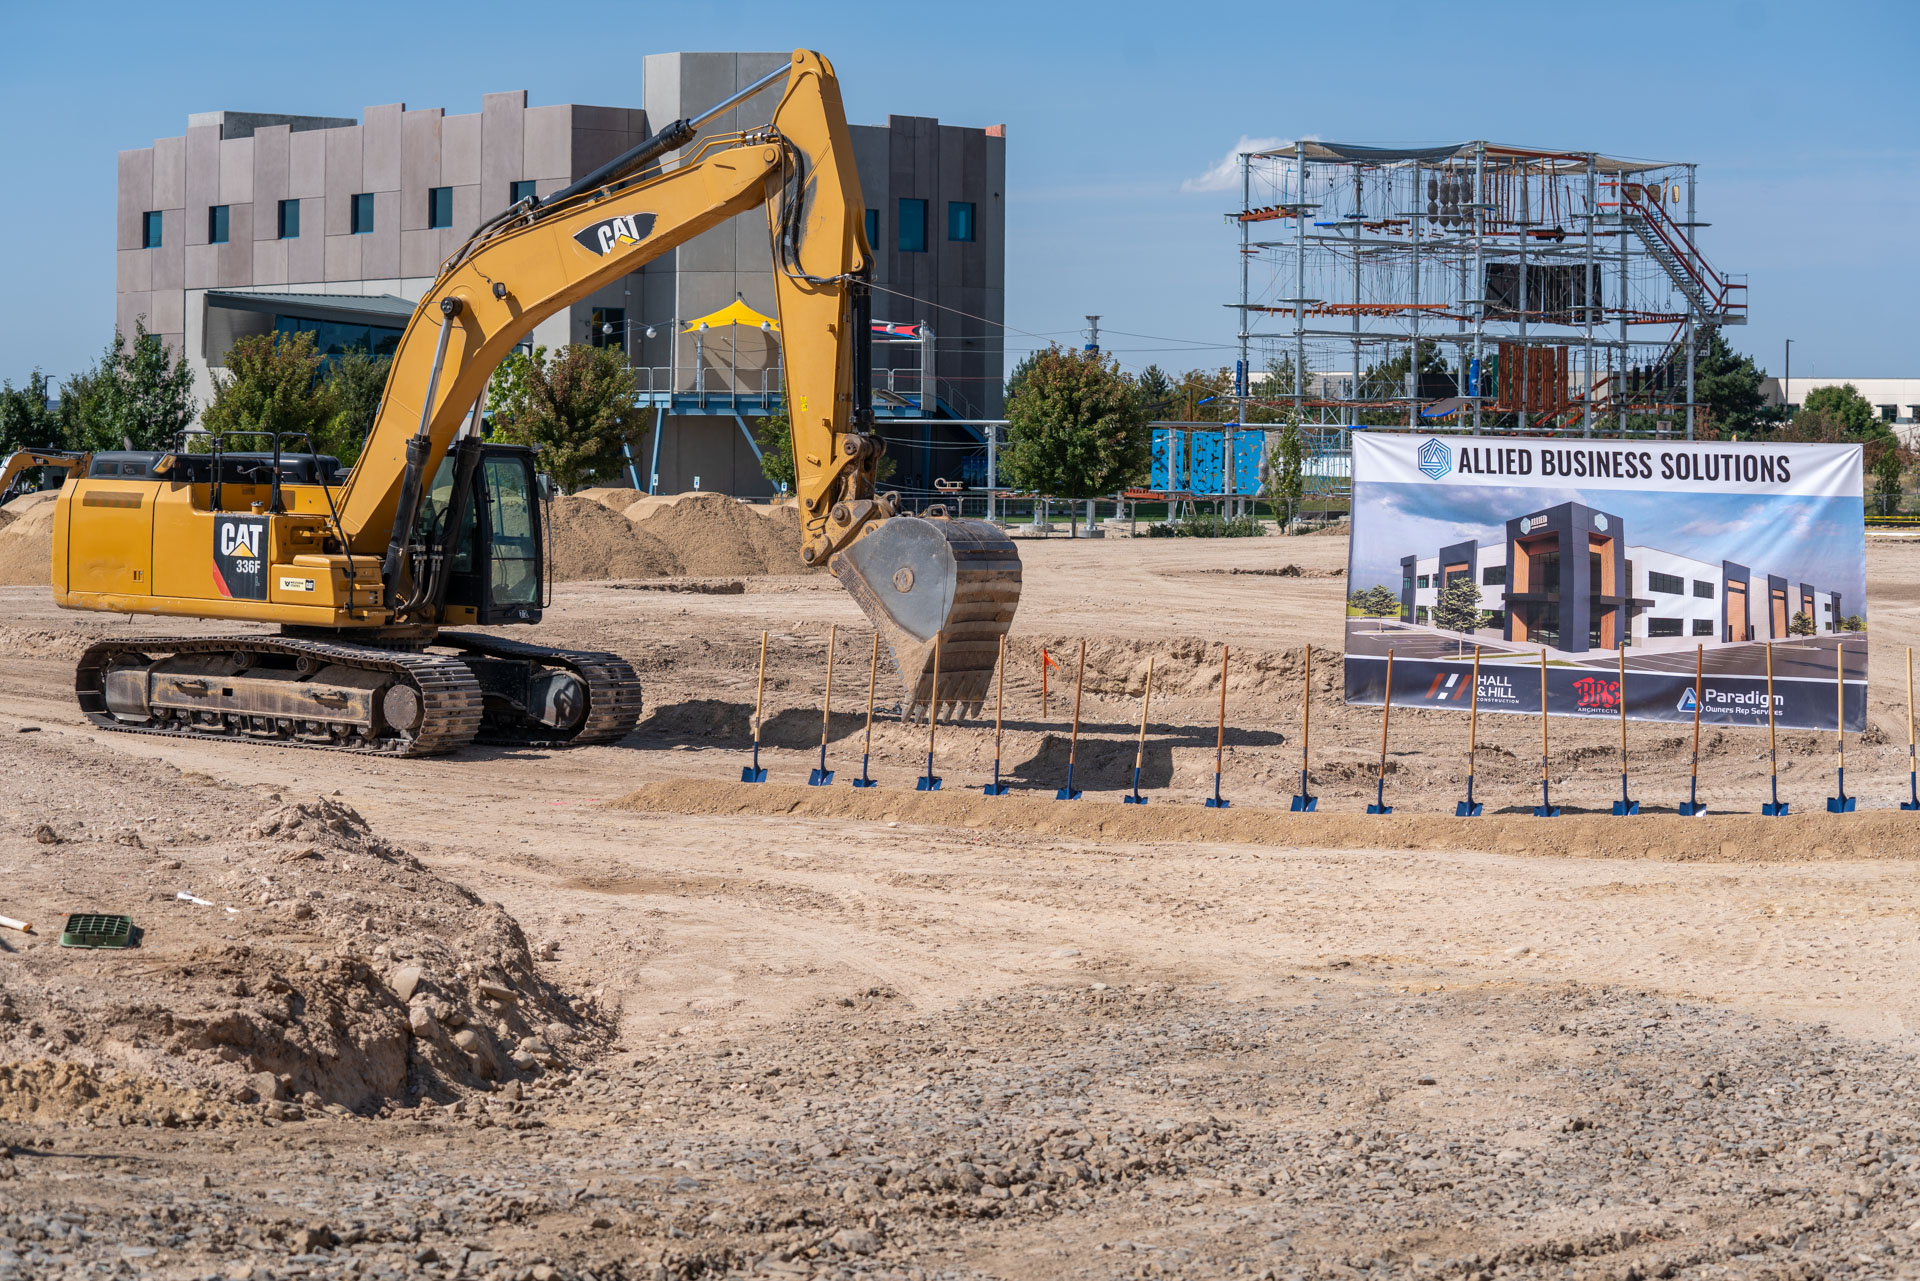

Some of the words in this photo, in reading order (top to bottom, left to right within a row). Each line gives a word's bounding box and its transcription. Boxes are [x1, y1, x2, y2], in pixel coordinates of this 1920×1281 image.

[598, 215, 640, 254] CAT
[1458, 447, 1532, 476] ALLIED
[1541, 449, 1652, 479] BUSINESS
[1661, 452, 1791, 483] SOLUTIONS
[221, 522, 263, 558] CAT
[236, 559, 261, 574] 336F
[1477, 675, 1512, 687] HALL
[1476, 686, 1487, 697] &
[1488, 686, 1516, 699] HILL
[1572, 677, 1621, 708] BRS
[1705, 688, 1784, 708] Paradigm
[1705, 705, 1734, 714] Owners
[1735, 707, 1750, 716] Rep
[1751, 707, 1784, 716] Serves
